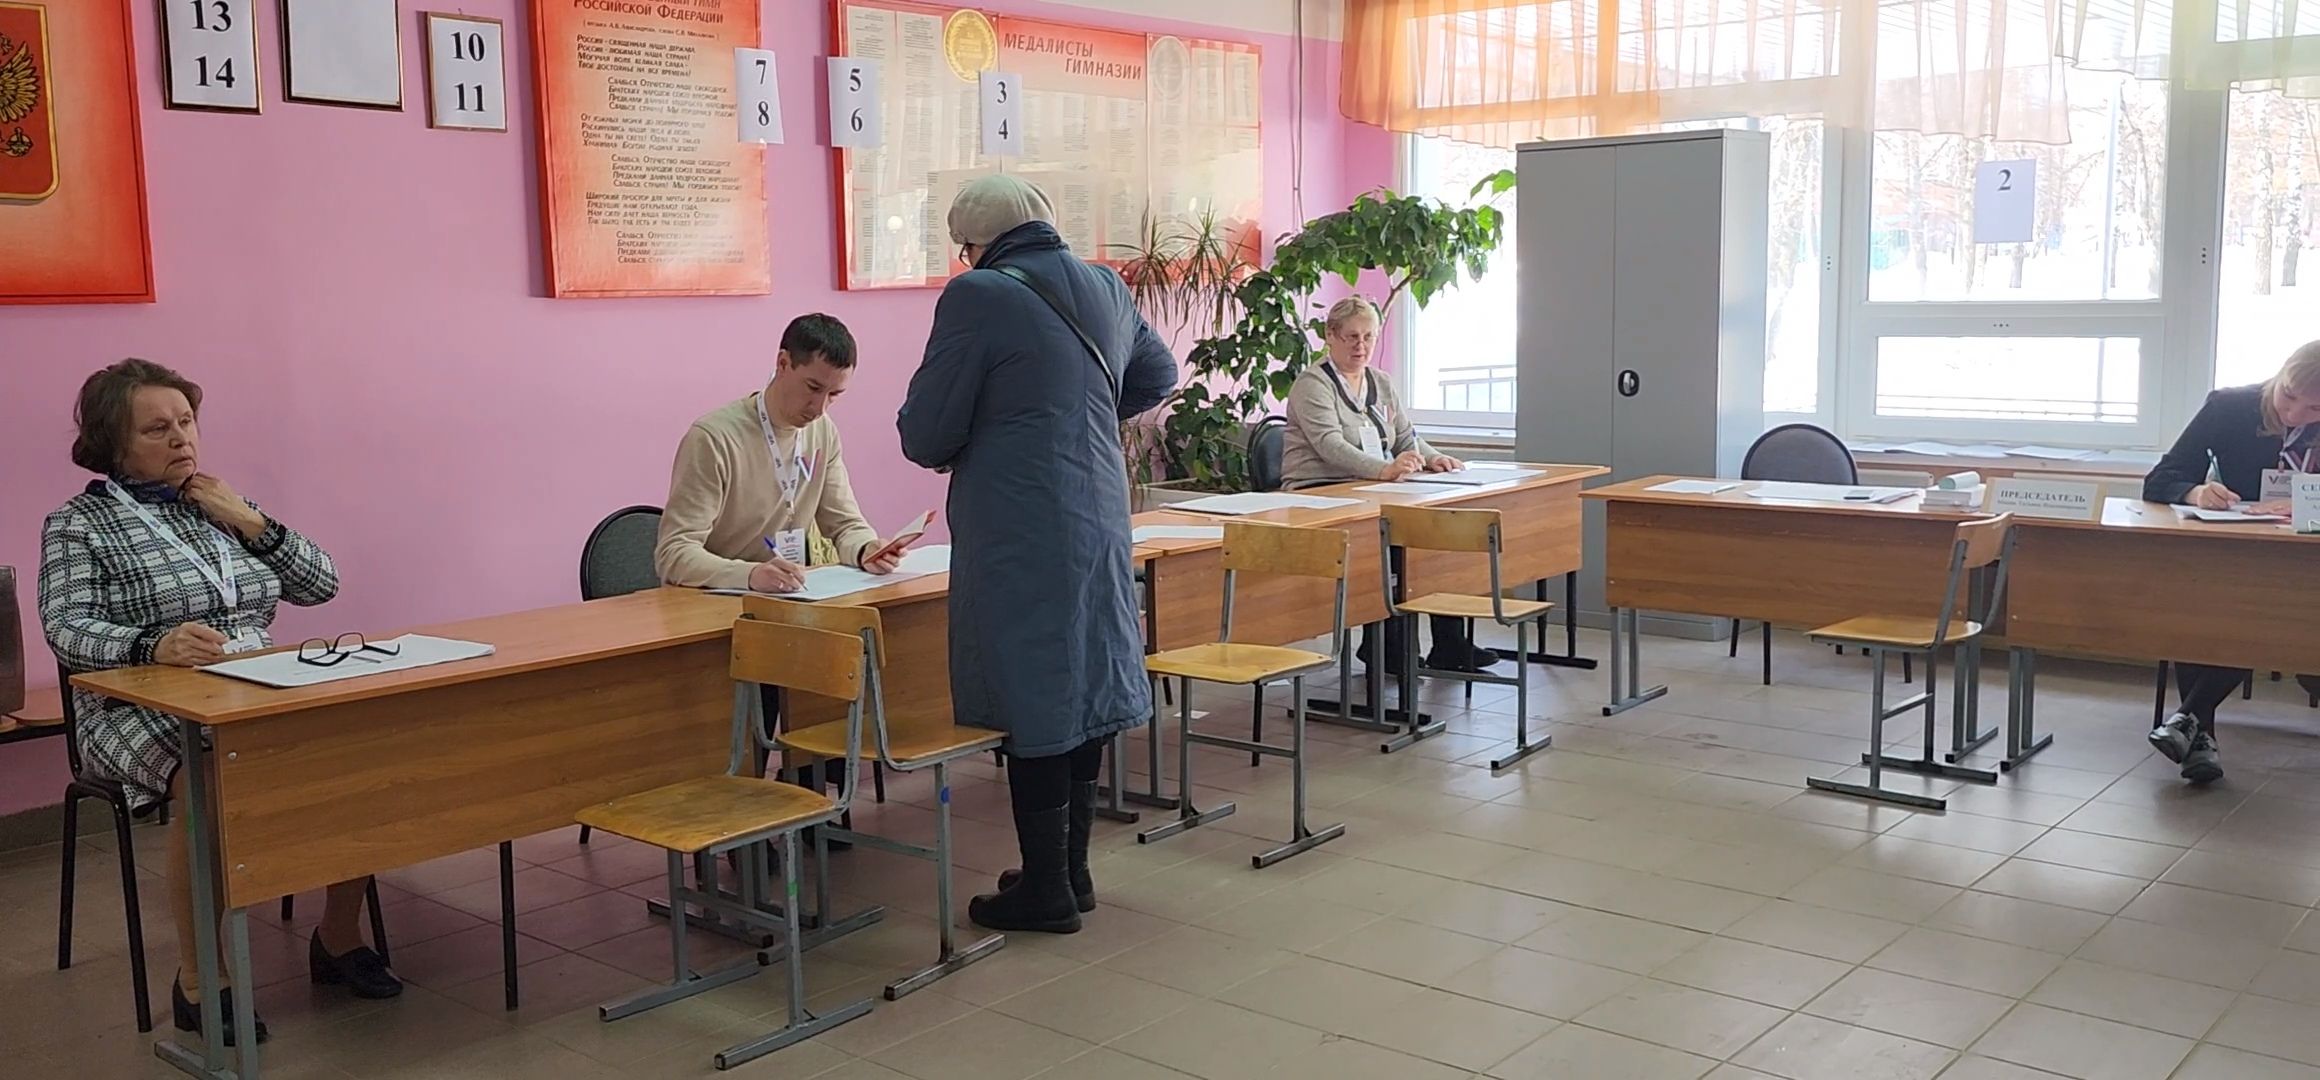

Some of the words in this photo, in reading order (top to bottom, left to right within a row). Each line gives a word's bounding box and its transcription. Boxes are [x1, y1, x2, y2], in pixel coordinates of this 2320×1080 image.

[191, 0, 232, 32] 13
[657, 4, 724, 23] ФЕДЕРАЦИИ
[451, 31, 485, 61] 10
[1004, 33, 1093, 58] МЕДАЛИСТЫ
[195, 55, 235, 88] 14
[755, 60, 767, 85] 7
[849, 68, 862, 91] 5
[1065, 58, 1142, 80] ГИМНАЗИИ
[454, 83, 486, 112] 11
[996, 81, 1007, 104] 3
[758, 101, 770, 126] 8
[850, 107, 863, 132] 6
[998, 118, 1008, 140] 4
[1997, 169, 2012, 191] 2
[2000, 490, 2086, 503] ПРЕДСЕДАТЕЛЬ
